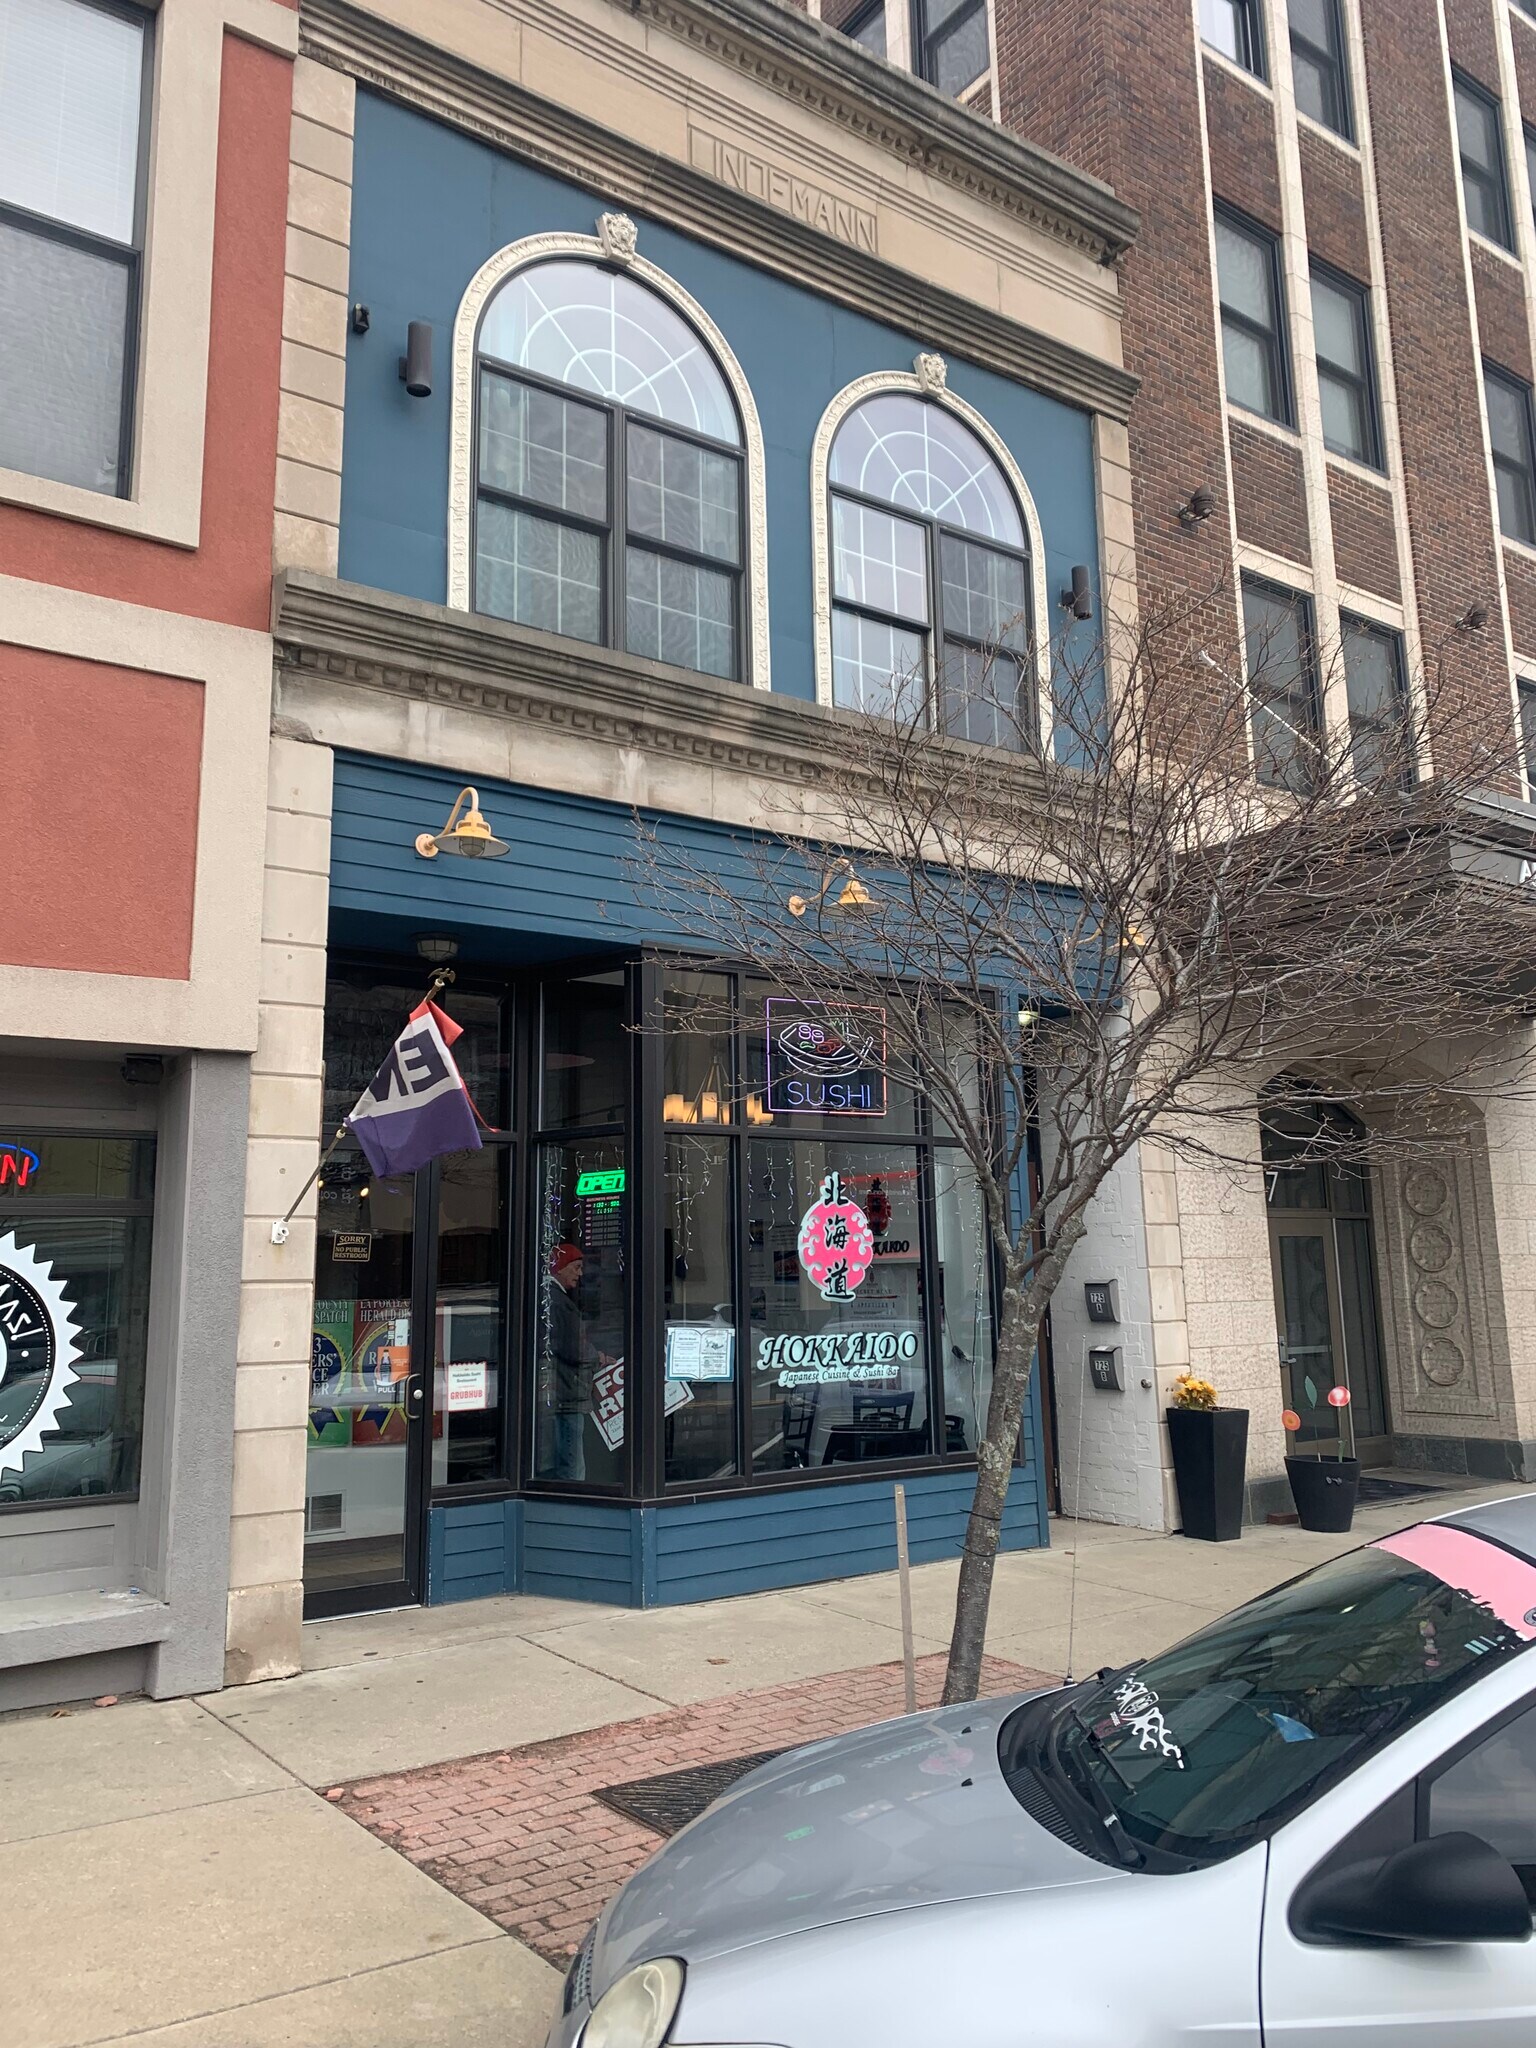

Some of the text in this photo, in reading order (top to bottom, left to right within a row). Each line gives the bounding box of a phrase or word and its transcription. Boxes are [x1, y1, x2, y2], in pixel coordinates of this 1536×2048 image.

[786, 1081, 871, 1108] SUSHI
[579, 1173, 625, 1192] OPEN
[339, 1235, 366, 1243] SORRY
[314, 1310, 348, 1323] SPATCH
[757, 1331, 919, 1370] HOKKAIDO
[782, 1371, 819, 1384] Japanese
[822, 1370, 851, 1381] Cuisine
[852, 1371, 861, 1379] &
[863, 1367, 884, 1379] Sushi
[377, 1386, 396, 1394] PULL
[450, 1390, 482, 1400] GRUBHUB
